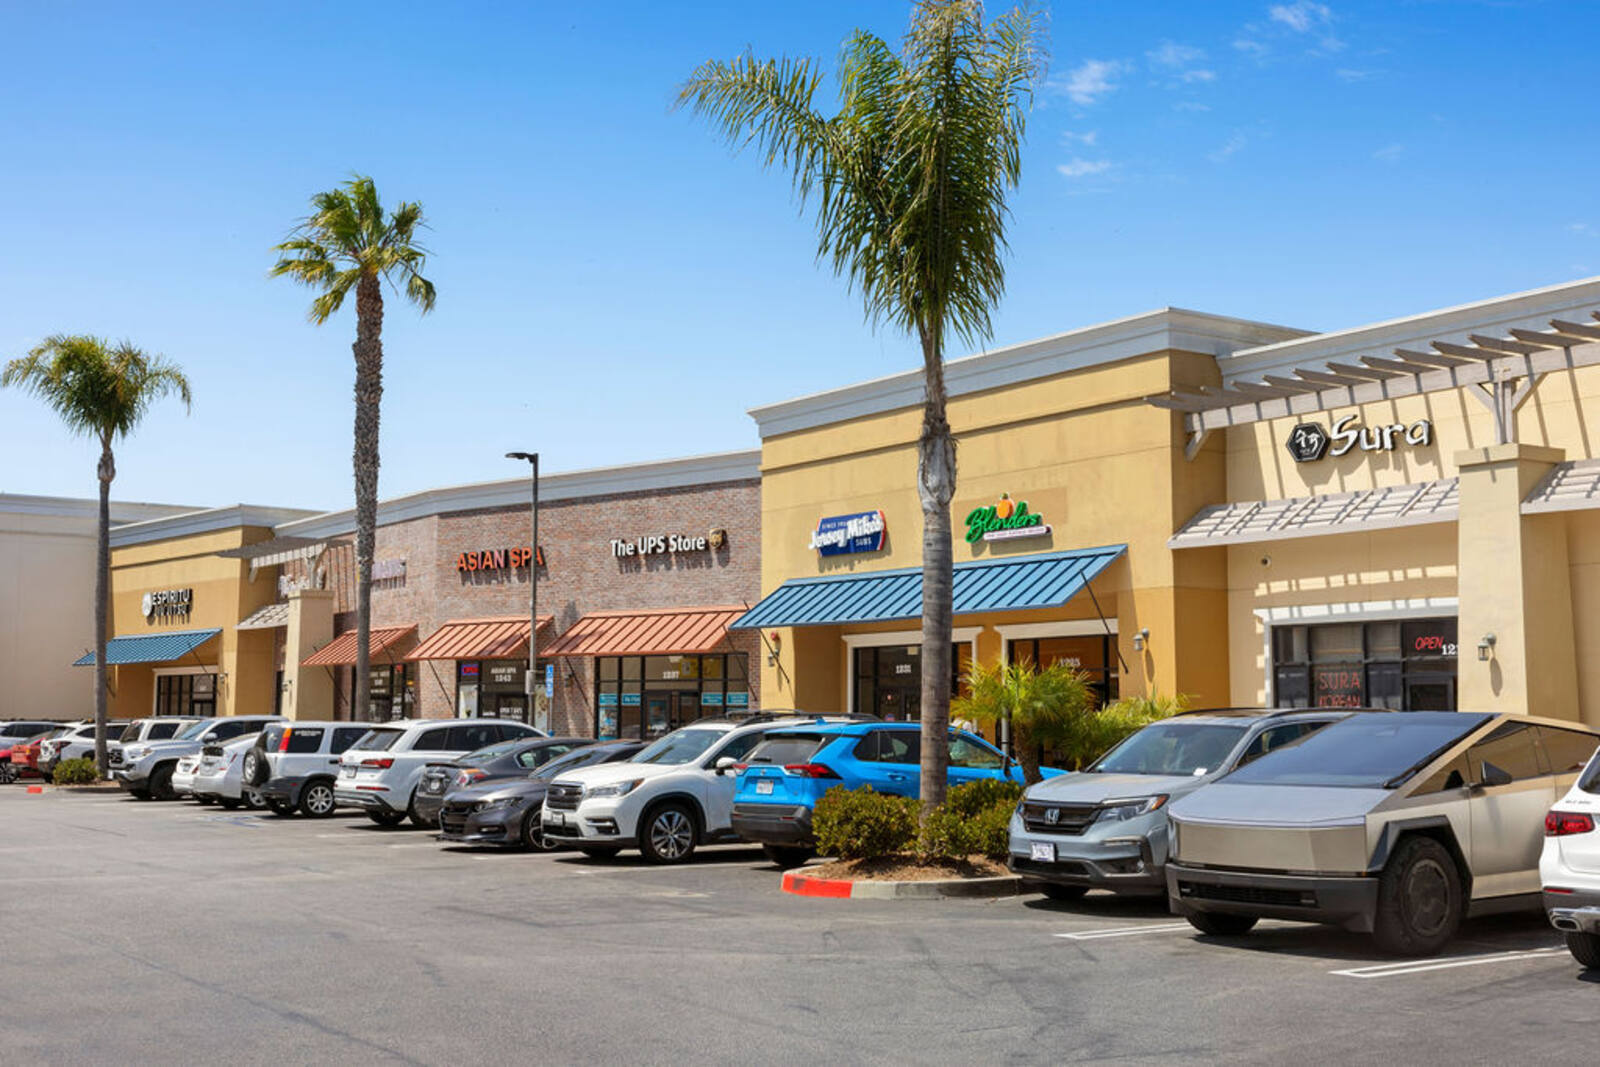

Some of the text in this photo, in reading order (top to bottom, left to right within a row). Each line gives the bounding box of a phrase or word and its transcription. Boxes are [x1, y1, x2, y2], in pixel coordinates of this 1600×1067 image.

[1330, 415, 1430, 456] Sura
[964, 500, 1043, 544] Blenders
[609, 533, 706, 557] The UPS Store
[456, 548, 506, 572] ASIAN
[152, 588, 191, 605] ESPIRITU
[1415, 636, 1444, 651] OPEN
[1441, 643, 1458, 656] 12
[1319, 671, 1361, 691] SURA
